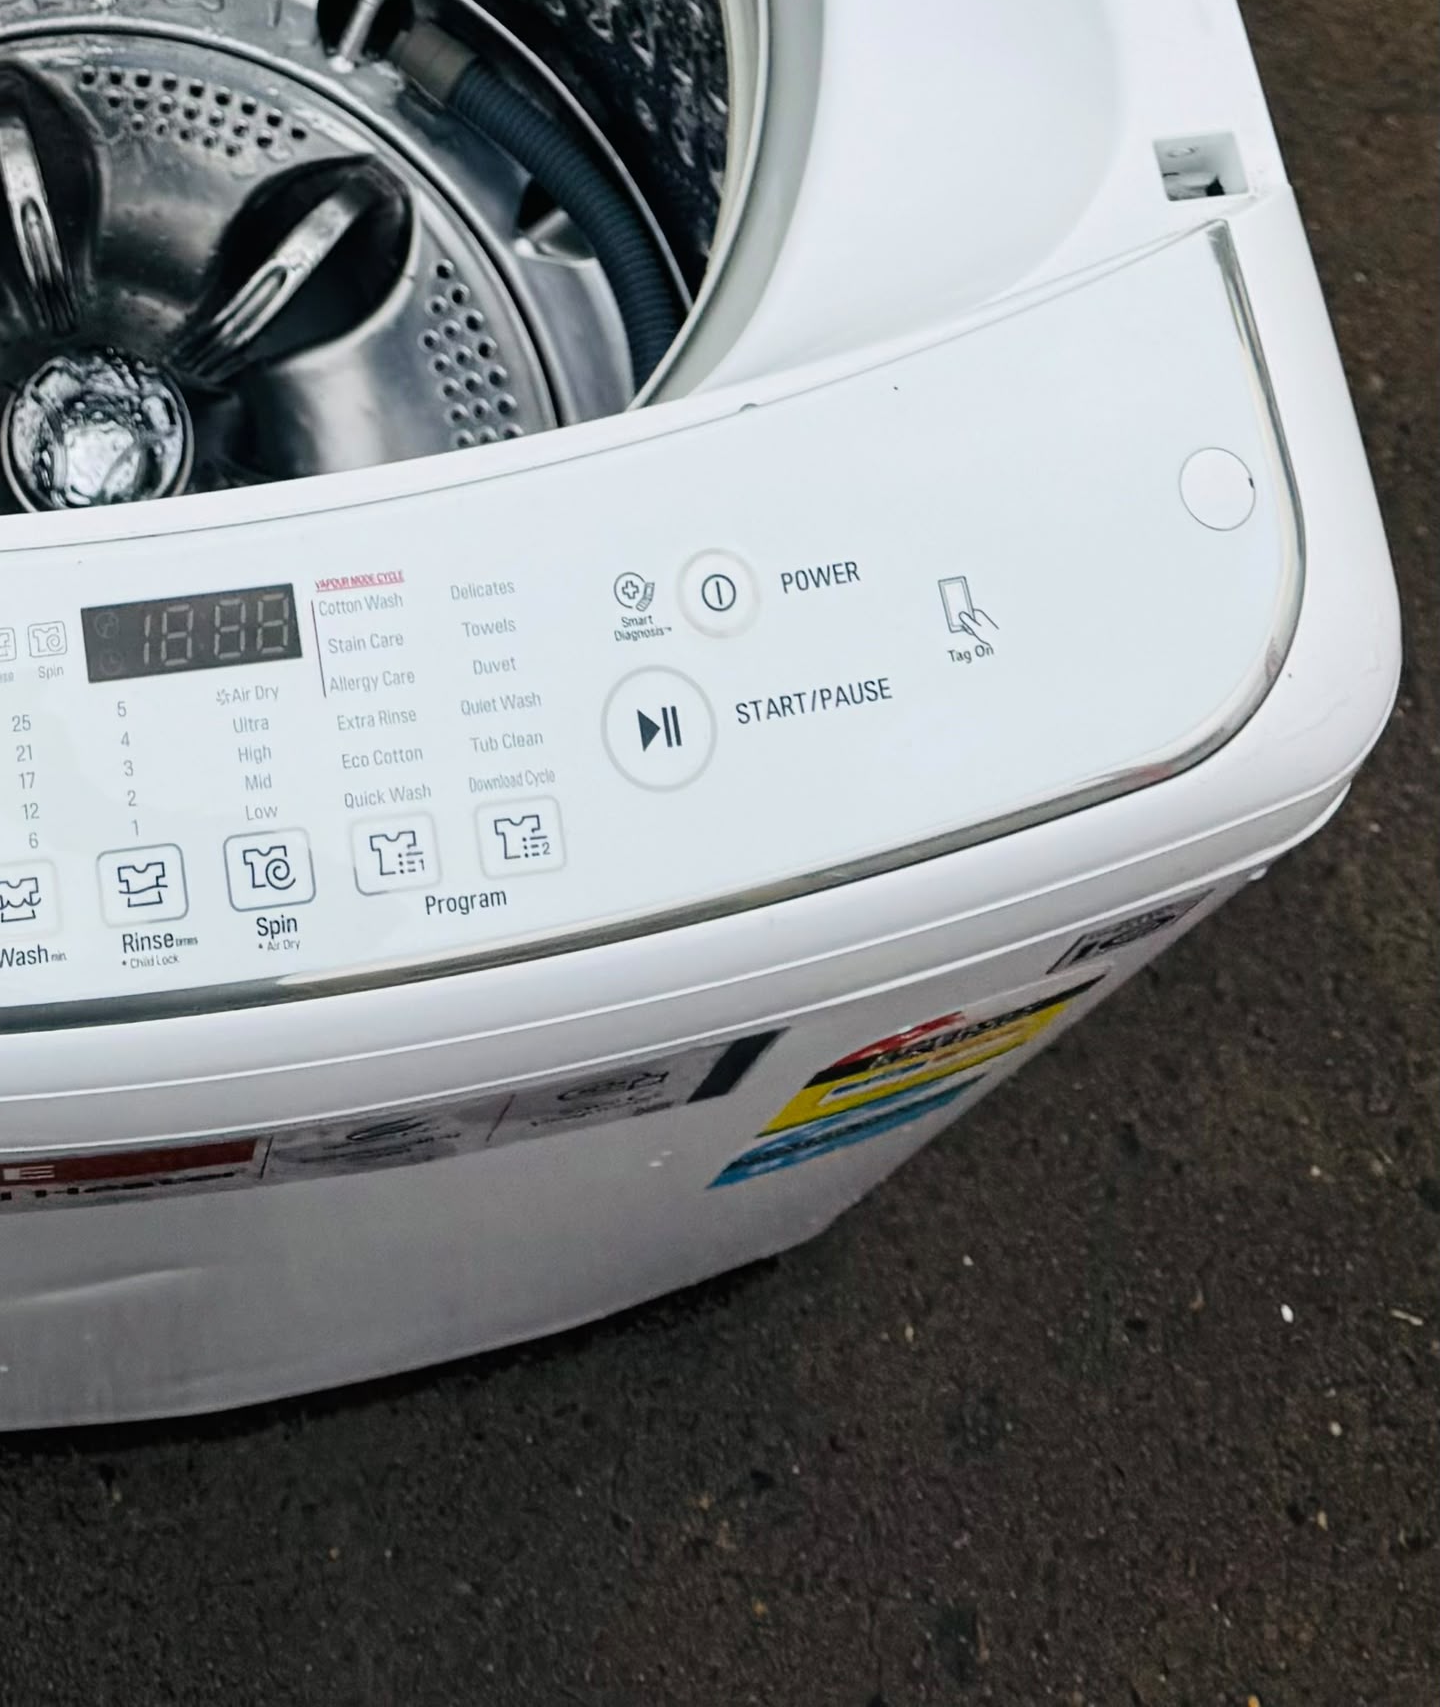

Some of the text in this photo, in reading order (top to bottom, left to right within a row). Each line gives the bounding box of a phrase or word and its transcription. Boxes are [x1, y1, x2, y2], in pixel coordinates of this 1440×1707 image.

[781, 561, 860, 594] POWER
[450, 581, 515, 600] Delicates
[319, 593, 403, 616] Cotton Wash
[462, 618, 516, 637] Towels
[621, 614, 653, 628] Smart
[328, 632, 404, 654] Stain Care
[947, 643, 994, 664] Tag On
[38, 665, 64, 680] Spin
[472, 657, 516, 675] Duvet
[329, 670, 415, 693] Allergy Care
[232, 685, 279, 702] Air Dry
[735, 678, 893, 725] START/PAUSE
[117, 701, 127, 717] 5
[460, 692, 541, 716] Quiet Wash
[12, 714, 31, 733] 25
[232, 717, 269, 733] Ultra
[337, 708, 417, 731] Extra Rinse
[121, 731, 130, 747] 4
[469, 732, 544, 753] Tub Clean
[16, 744, 33, 762] 21
[238, 745, 272, 764] High
[341, 748, 423, 769] Eco Cotton
[123, 760, 134, 777] 3
[19, 771, 35, 789] 17
[245, 773, 272, 790] Mid
[468, 768, 555, 793] Download Cycle
[127, 790, 137, 807] 2
[344, 783, 431, 808] Quick Wash
[22, 802, 40, 820] 12
[245, 805, 278, 820] Low
[132, 819, 139, 837] 1
[29, 832, 39, 849] 6
[424, 890, 508, 916] Program
[256, 915, 299, 938] Spin
[122, 932, 175, 953] Rinse
[267, 938, 300, 952] Air Dry
[130, 954, 179, 969] Child Lock
